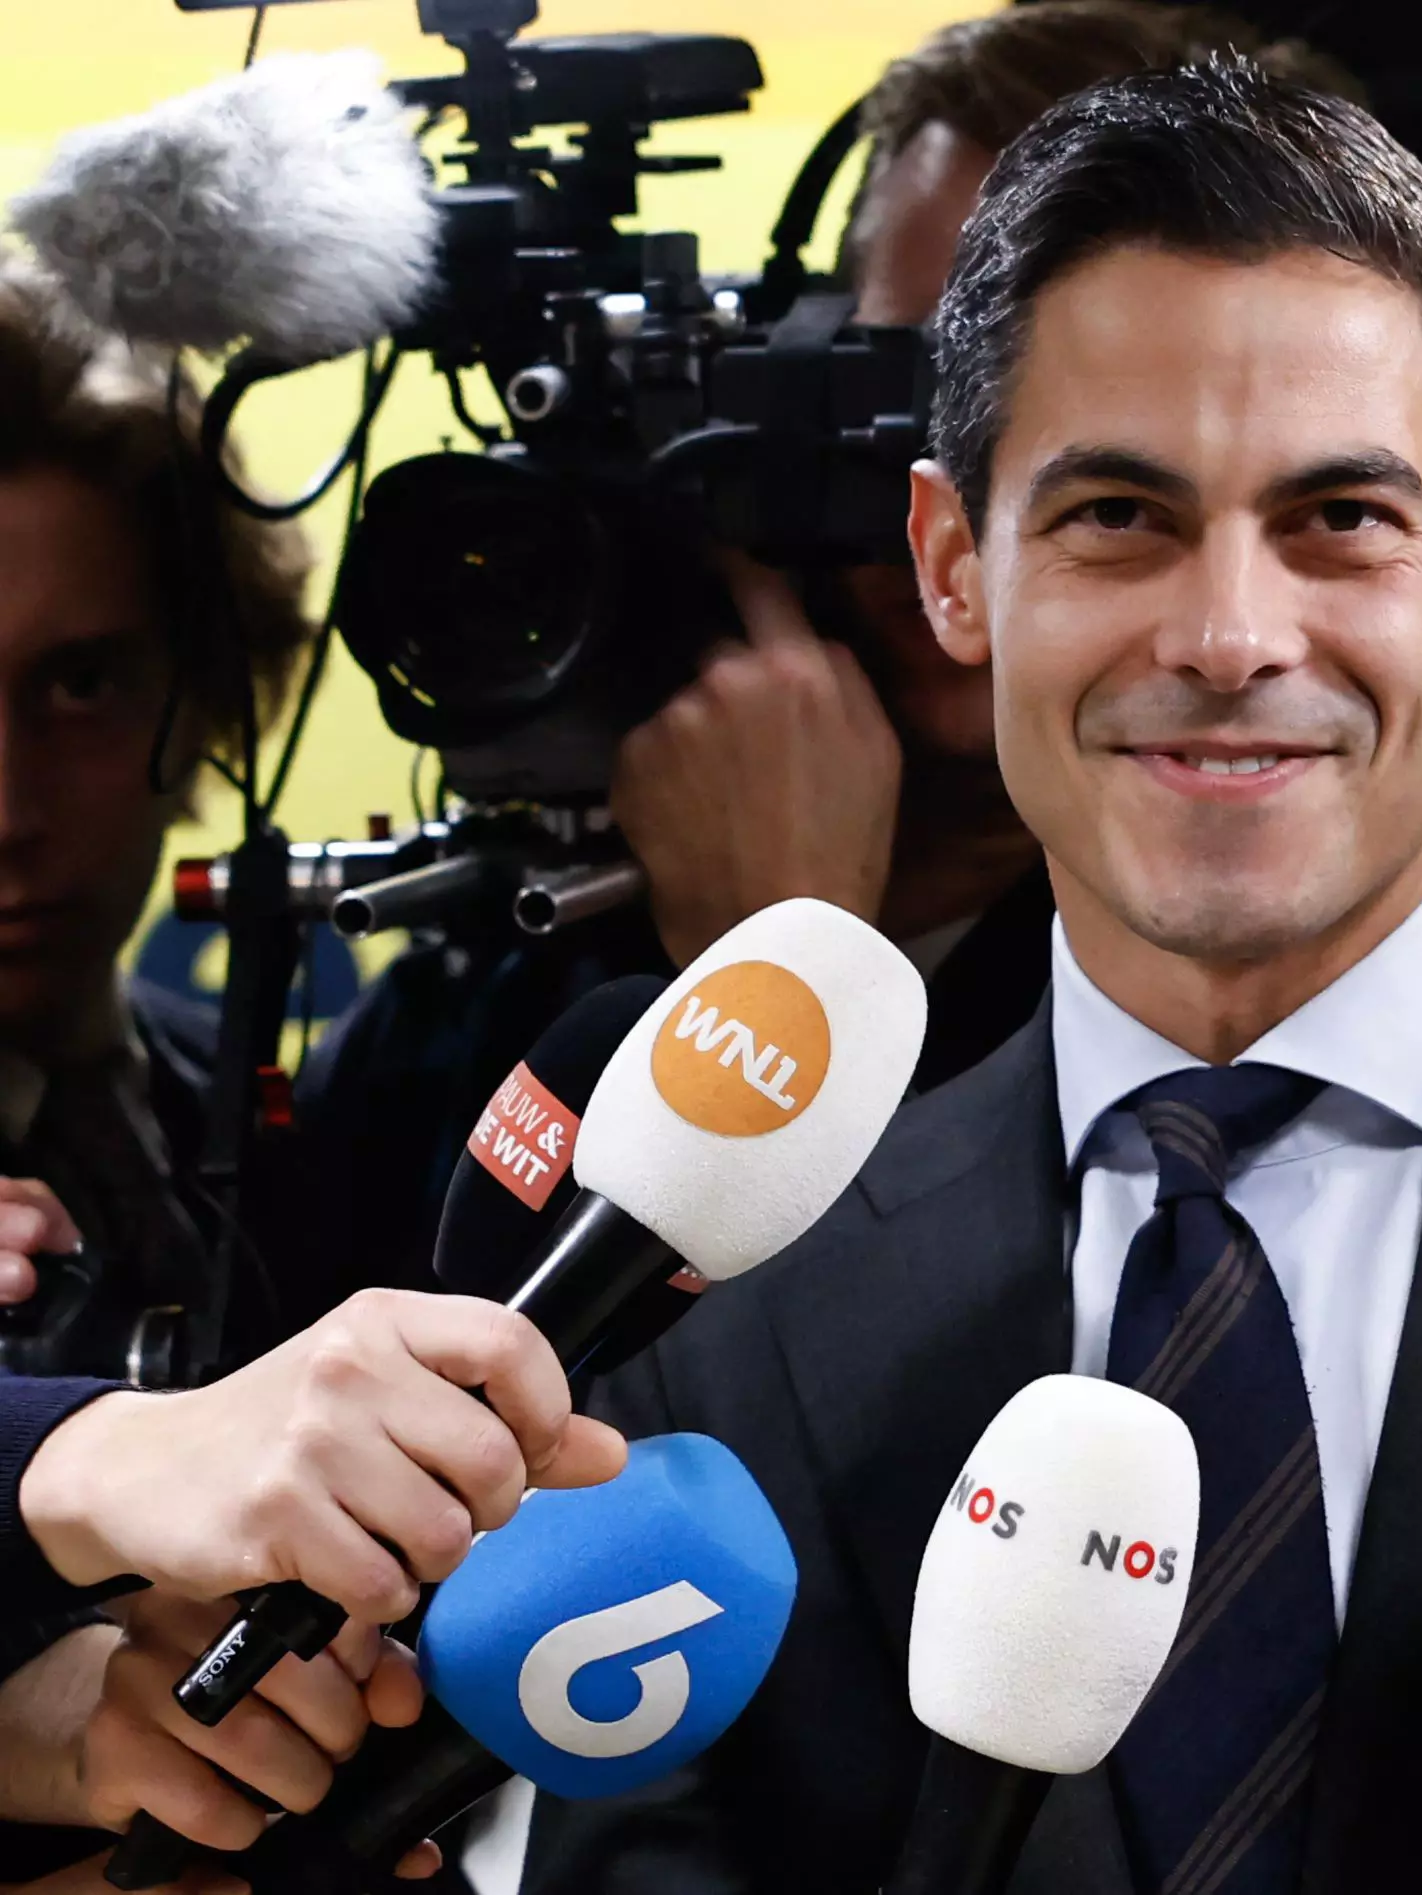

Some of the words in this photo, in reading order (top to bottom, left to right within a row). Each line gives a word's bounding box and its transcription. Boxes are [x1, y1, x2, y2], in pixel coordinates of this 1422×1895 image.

[674, 995, 797, 1111] WNL
[474, 1108, 500, 1145] DE
[491, 1126, 551, 1187] WIT
[498, 1073, 549, 1135] PAUW
[537, 1121, 567, 1160] &
[949, 1471, 1025, 1540] NOS
[1080, 1529, 1179, 1586] NOS
[198, 1631, 246, 1688] SONY
